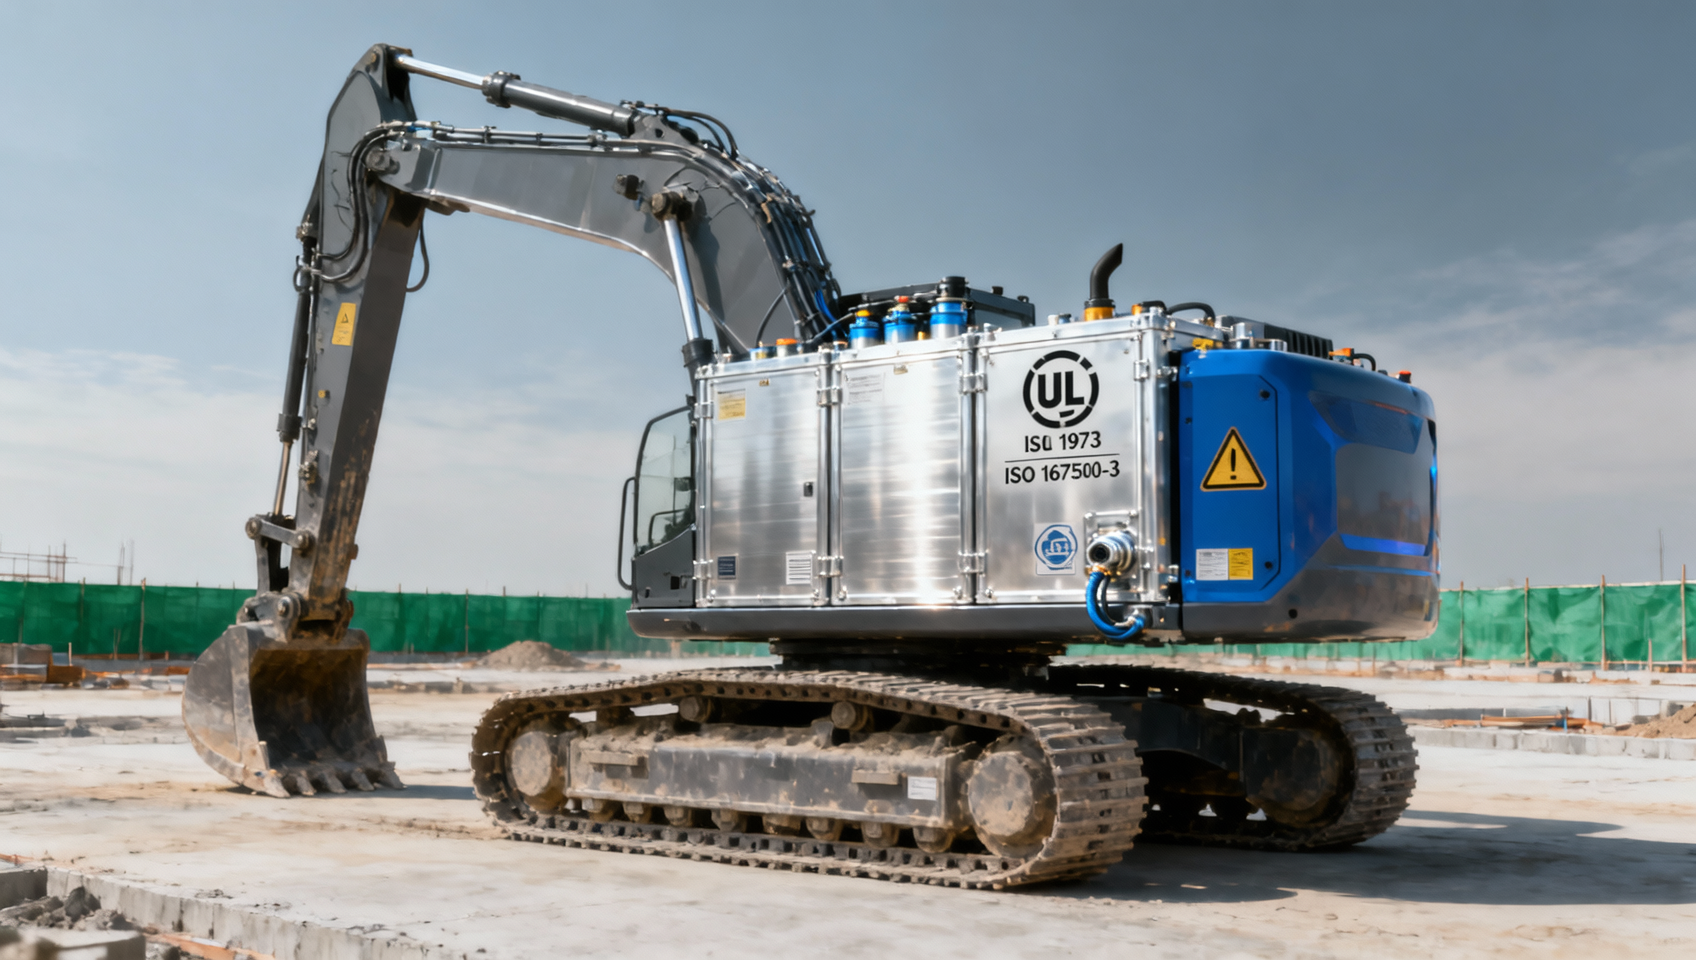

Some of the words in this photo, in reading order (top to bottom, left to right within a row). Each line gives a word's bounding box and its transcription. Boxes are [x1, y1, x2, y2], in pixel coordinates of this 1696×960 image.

[1038, 371, 1085, 408] UL
[1059, 430, 1102, 450] 1973
[1005, 466, 1035, 484] ISO
[1041, 460, 1120, 482] 167500-3
